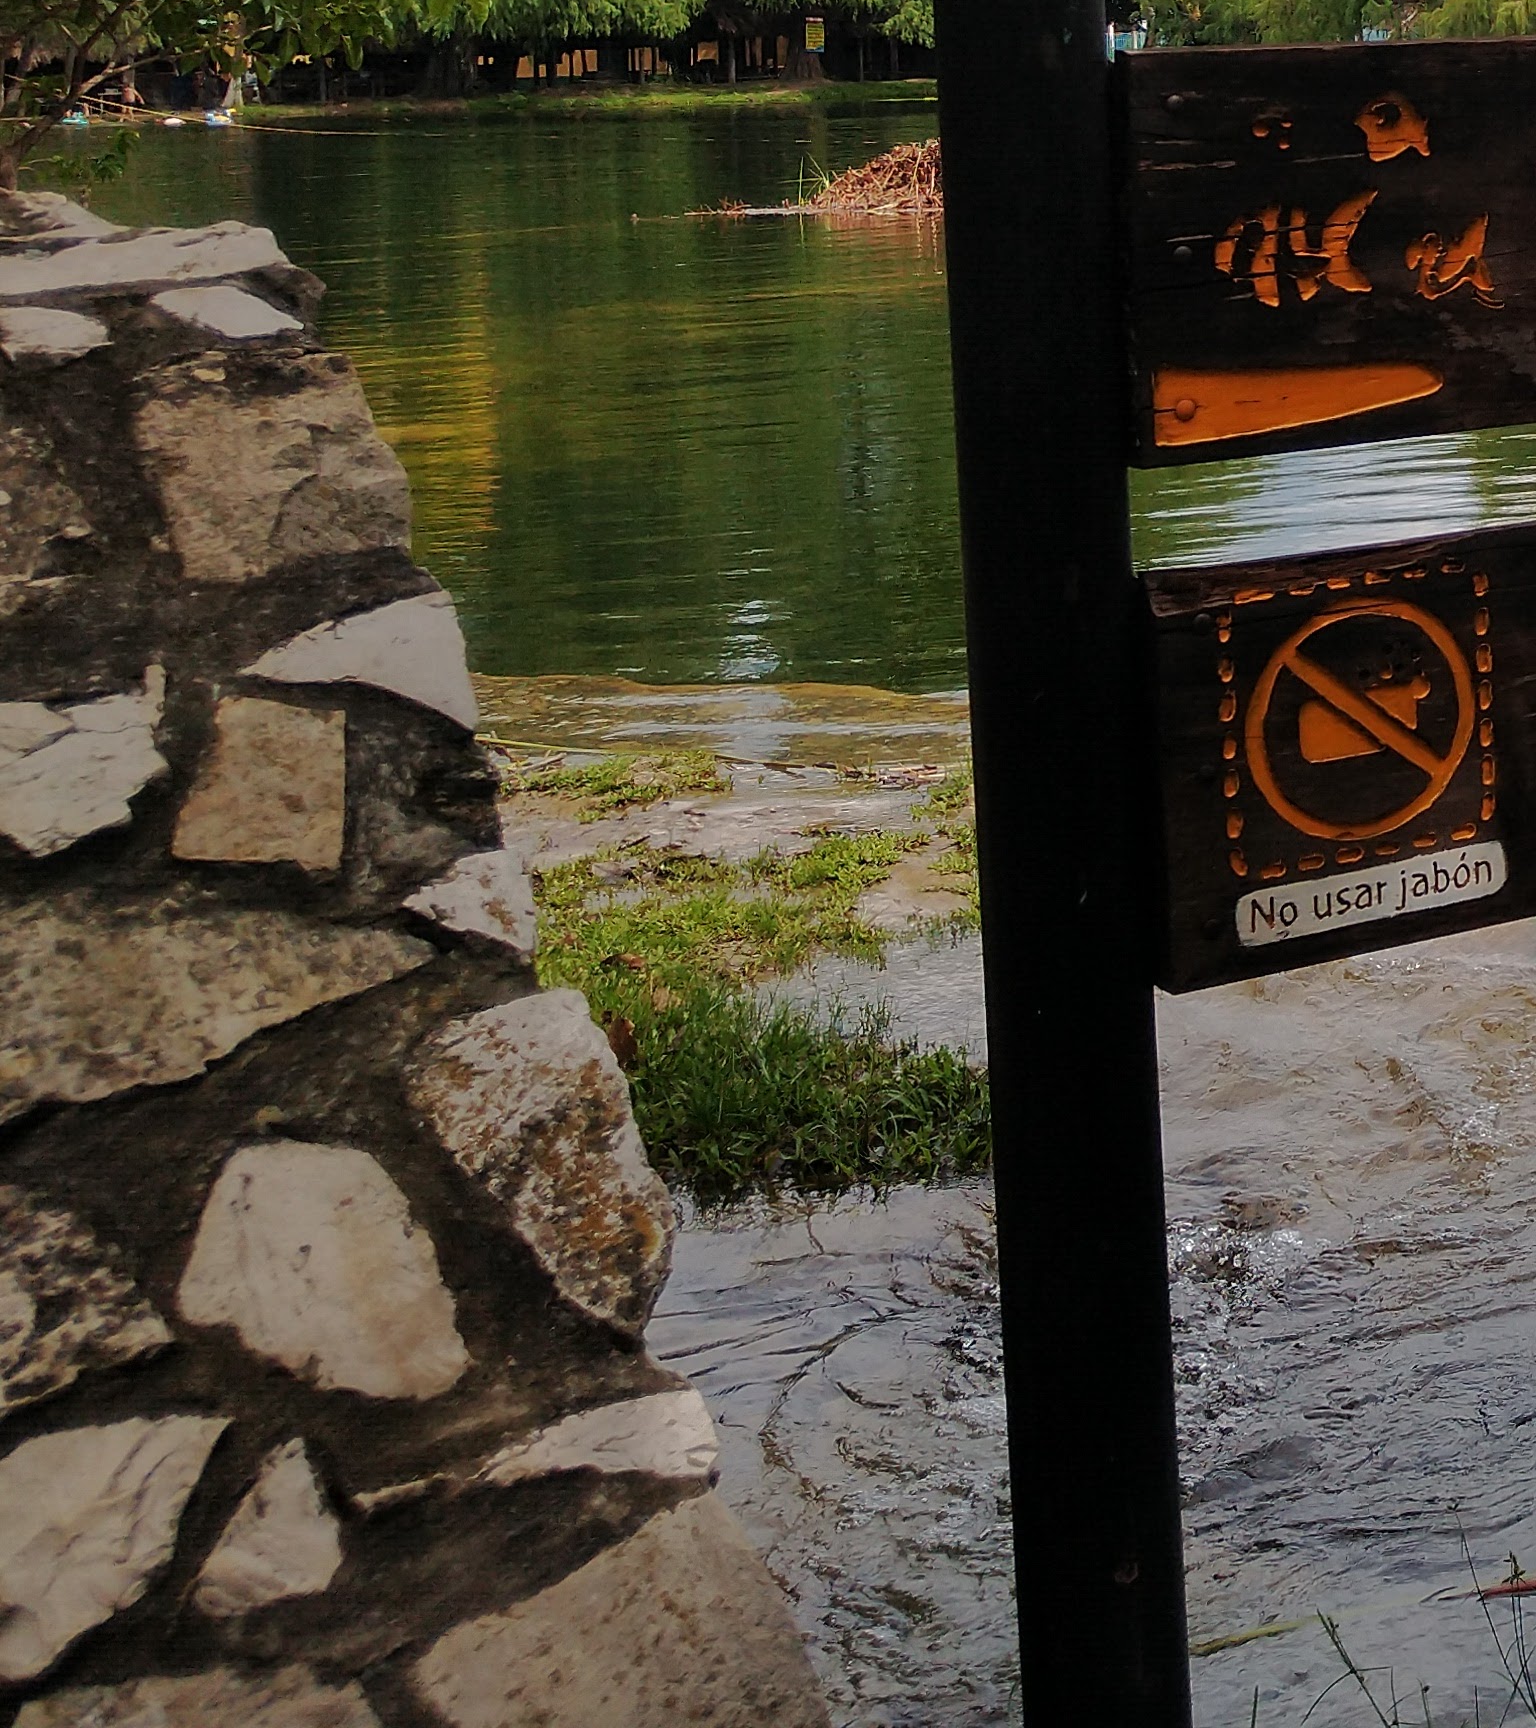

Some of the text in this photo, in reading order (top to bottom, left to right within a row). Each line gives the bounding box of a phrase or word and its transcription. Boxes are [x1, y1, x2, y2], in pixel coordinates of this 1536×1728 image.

[1250, 852, 1493, 933] No usar jabón
